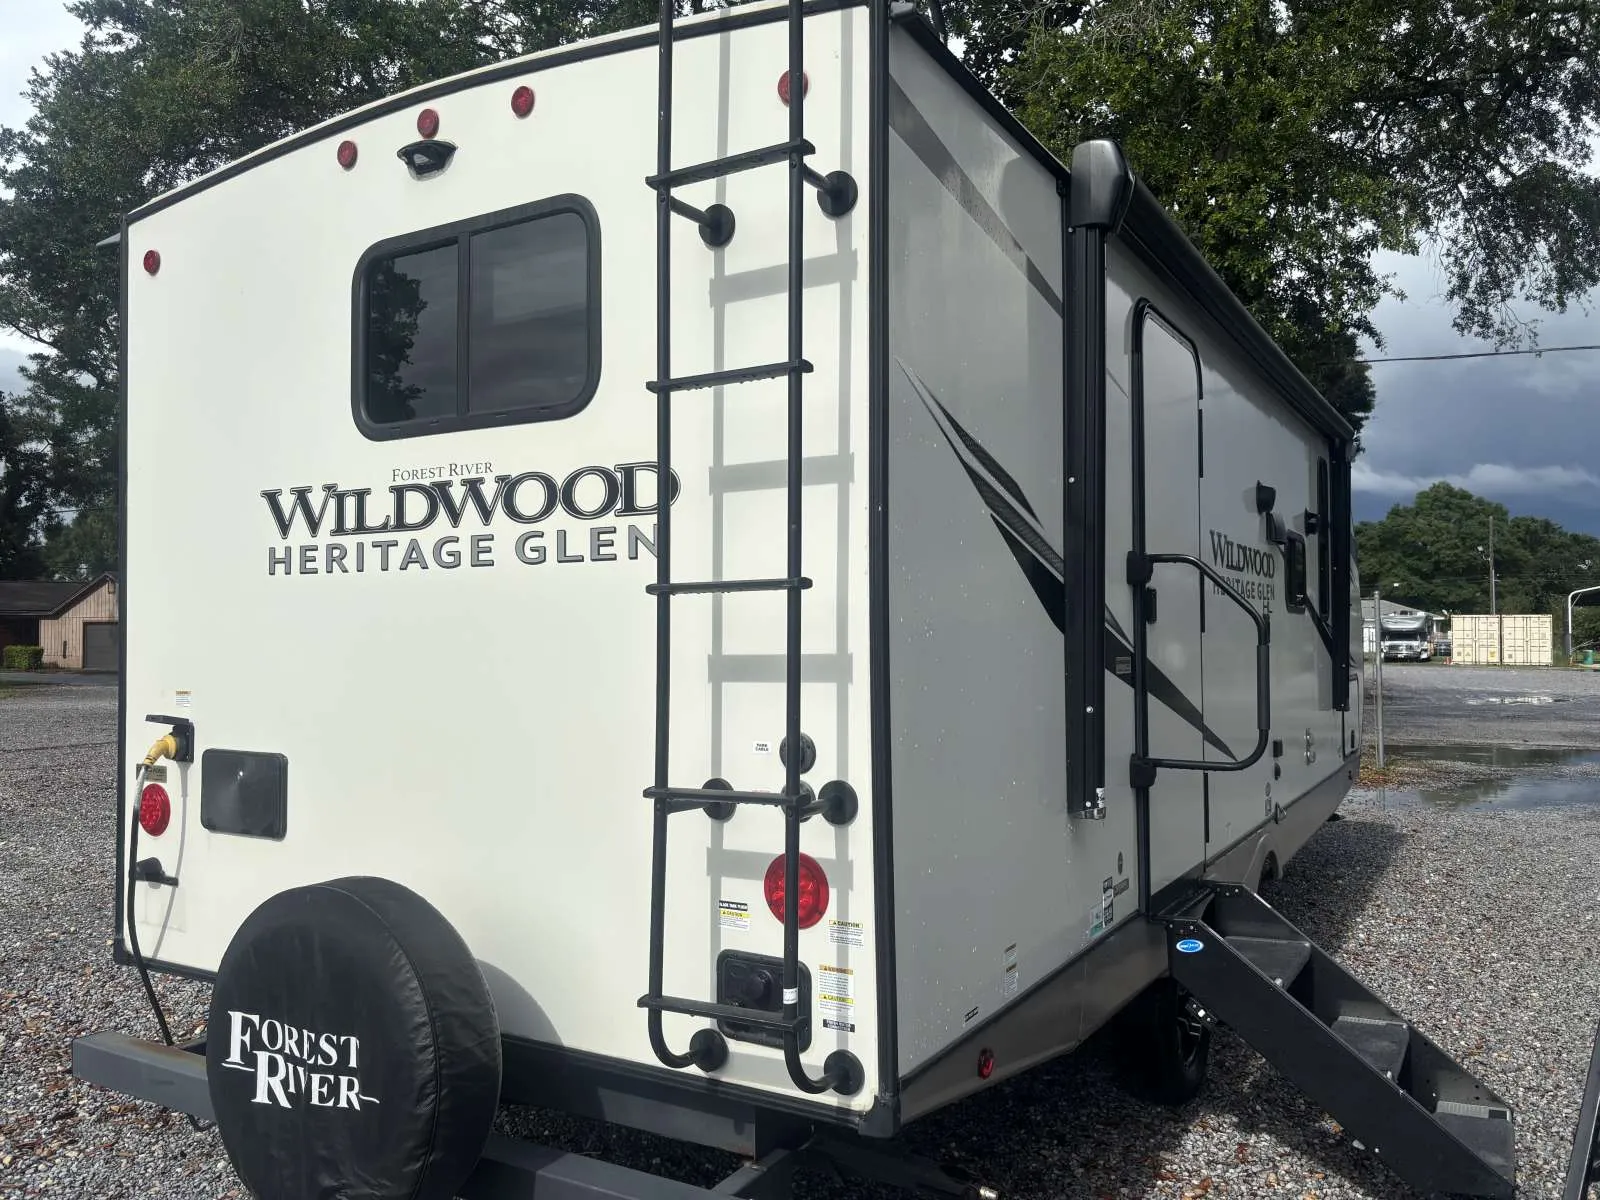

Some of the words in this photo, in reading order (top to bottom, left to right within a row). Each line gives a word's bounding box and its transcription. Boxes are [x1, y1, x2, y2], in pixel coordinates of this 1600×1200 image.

[392, 466, 445, 482] FOREST
[448, 462, 493, 477] RIVER
[260, 461, 682, 540] WILDWOOD
[268, 533, 495, 576] HERITAGE
[514, 523, 658, 564] GLEN
[1209, 528, 1275, 579] WILDWOOD
[225, 1010, 361, 1068] FOREST
[251, 1050, 362, 1111] RIVER
